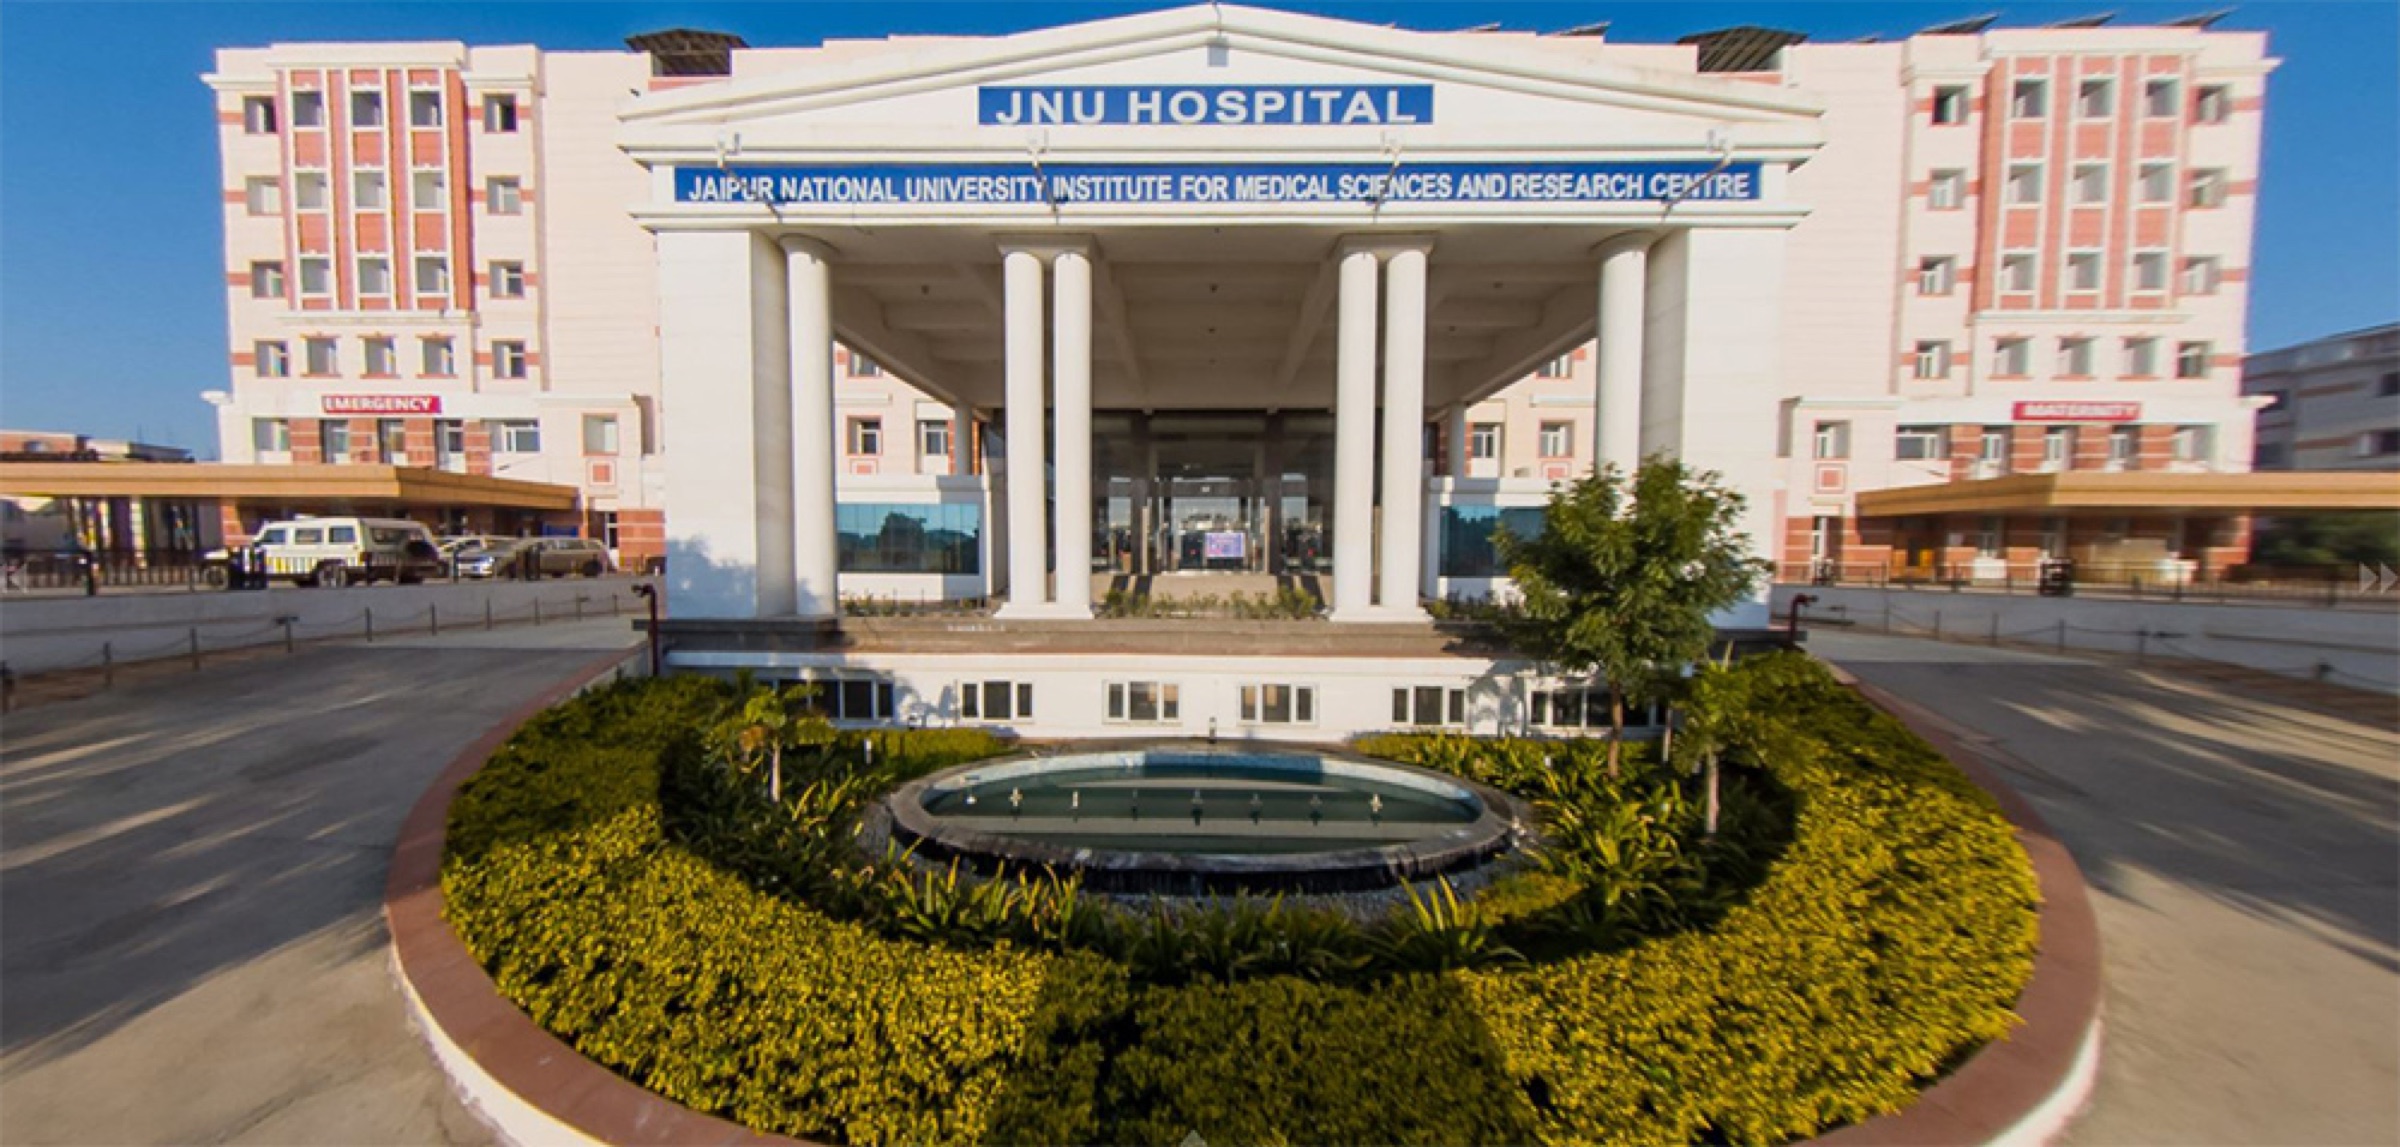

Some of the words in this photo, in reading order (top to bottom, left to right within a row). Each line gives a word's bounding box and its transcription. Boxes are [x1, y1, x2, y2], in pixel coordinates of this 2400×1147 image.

[995, 90, 1105, 124] JNU
[1127, 90, 1417, 124] HOSPITAL
[688, 176, 775, 201] JAIPUR
[779, 176, 898, 201] NATIONAL
[905, 175, 1046, 201] UNIVERSITY
[1052, 175, 1172, 200] INSTITUTE
[1180, 175, 1229, 200] FOR
[1235, 174, 1335, 200] MEDICAL
[1338, 174, 1453, 199] SCIENCES
[1456, 173, 1507, 199] AND
[1510, 172, 1645, 199] RESEARCH
[1649, 172, 1750, 198] CENTRE
[325, 396, 432, 410] EMERGENCY
